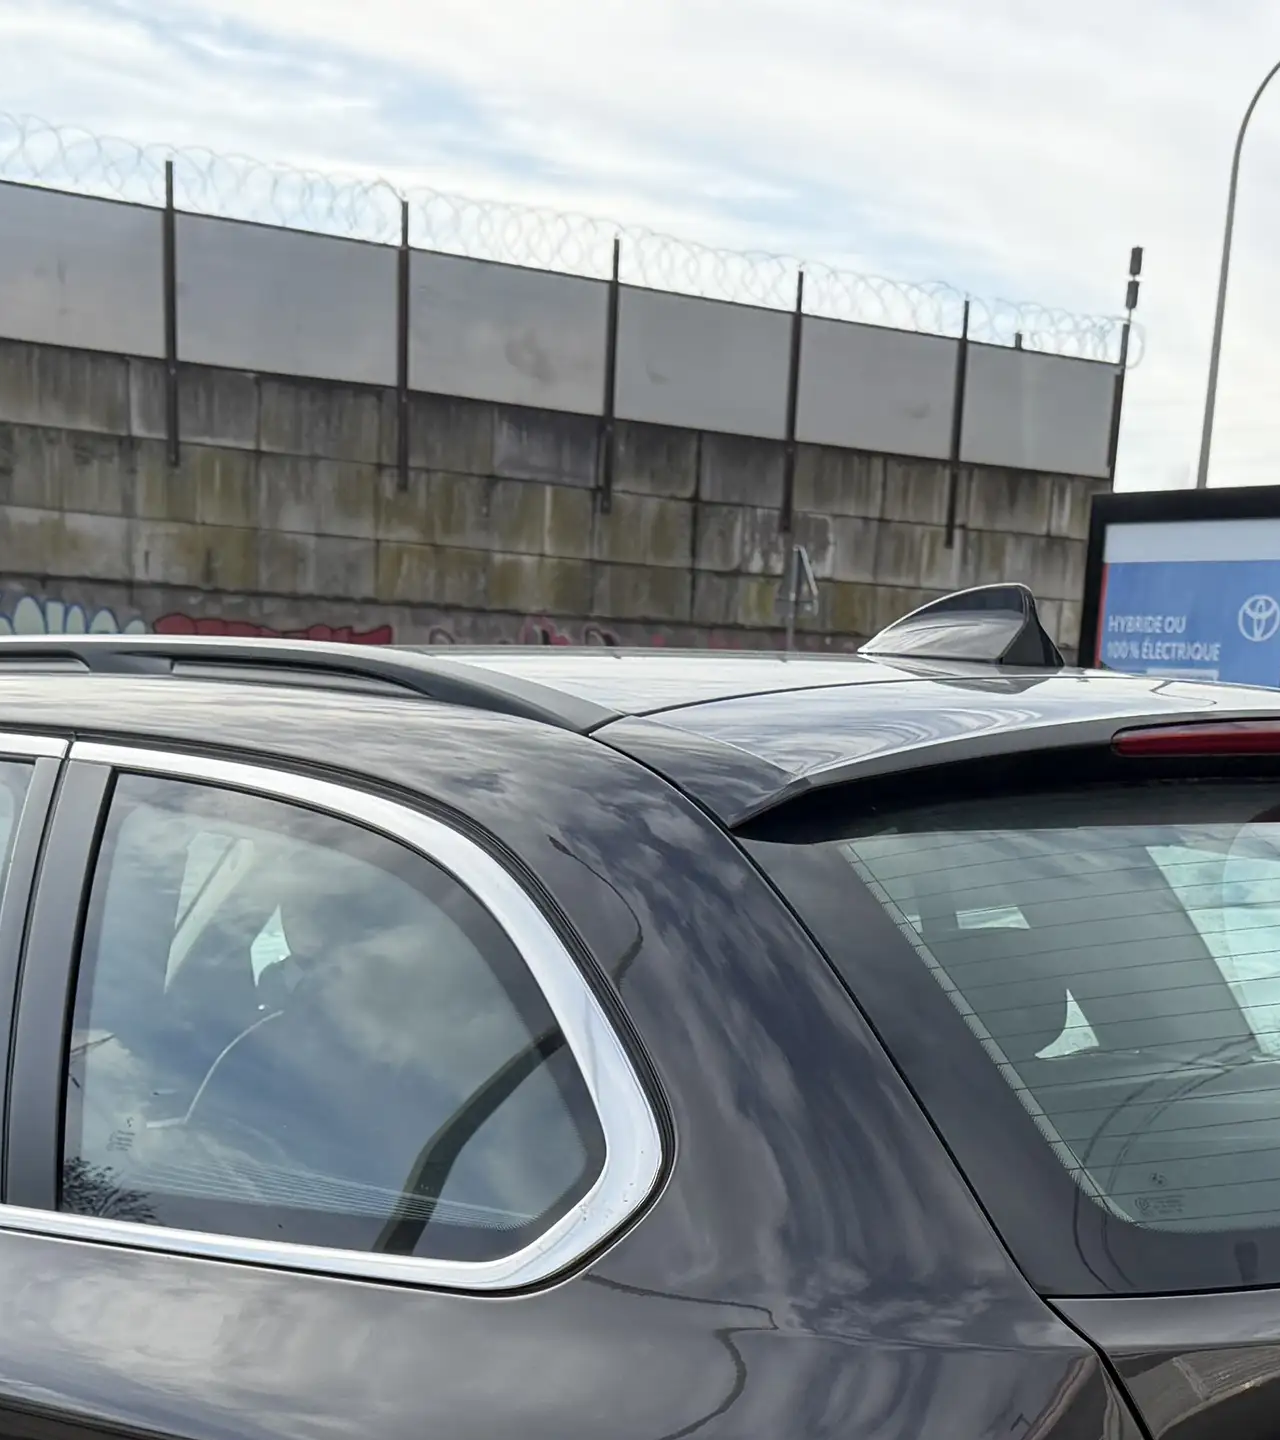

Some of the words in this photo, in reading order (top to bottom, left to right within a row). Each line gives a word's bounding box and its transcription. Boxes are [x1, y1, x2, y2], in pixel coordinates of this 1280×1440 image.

[1107, 614, 1163, 634] HYBRIDE
[1163, 613, 1188, 634] OU
[1141, 637, 1222, 662] ÉLECTRIQUE
